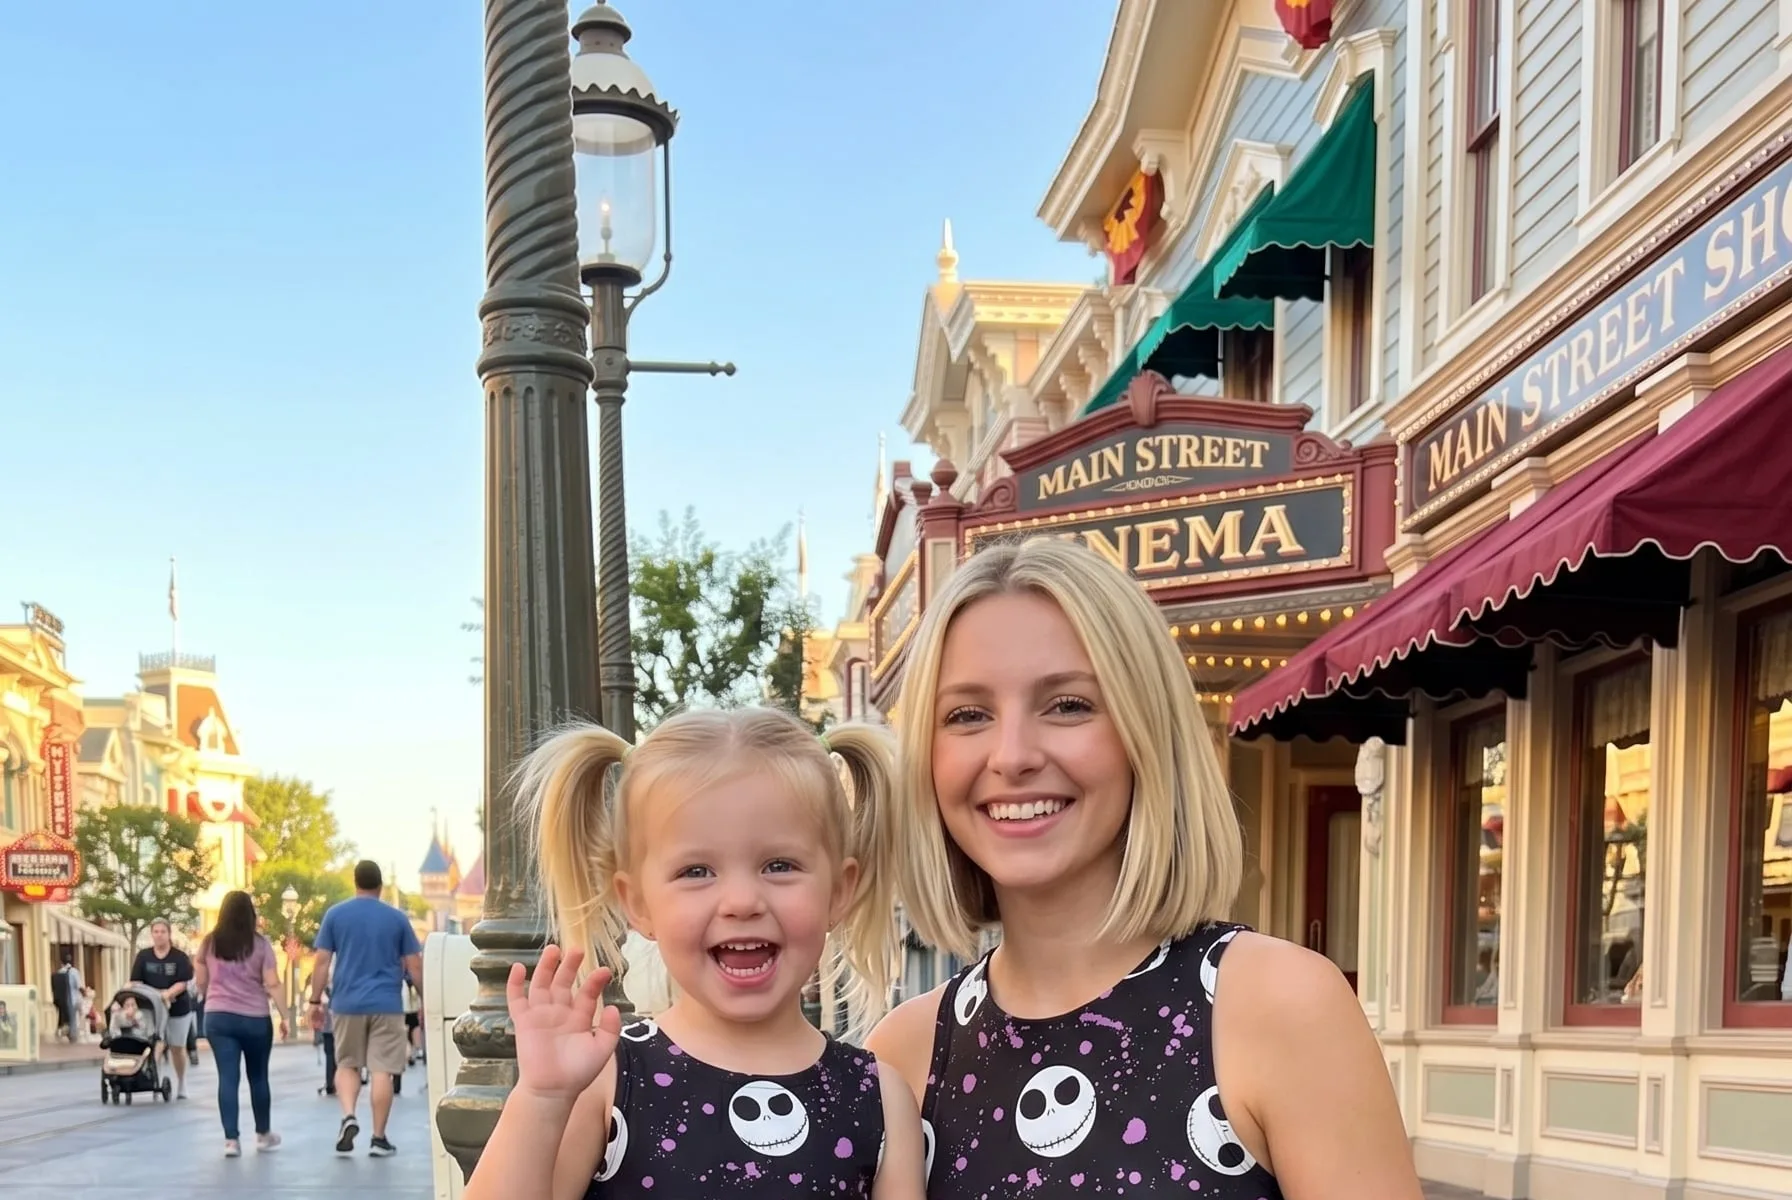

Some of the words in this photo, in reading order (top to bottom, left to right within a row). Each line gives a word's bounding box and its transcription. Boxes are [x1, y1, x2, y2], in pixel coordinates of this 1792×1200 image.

[1427, 388, 1509, 492] MAIN
[1522, 258, 1684, 428] STREET
[1037, 442, 1126, 500] MAIN
[1135, 434, 1270, 472] STREET
[1060, 505, 1306, 573] NEMA
